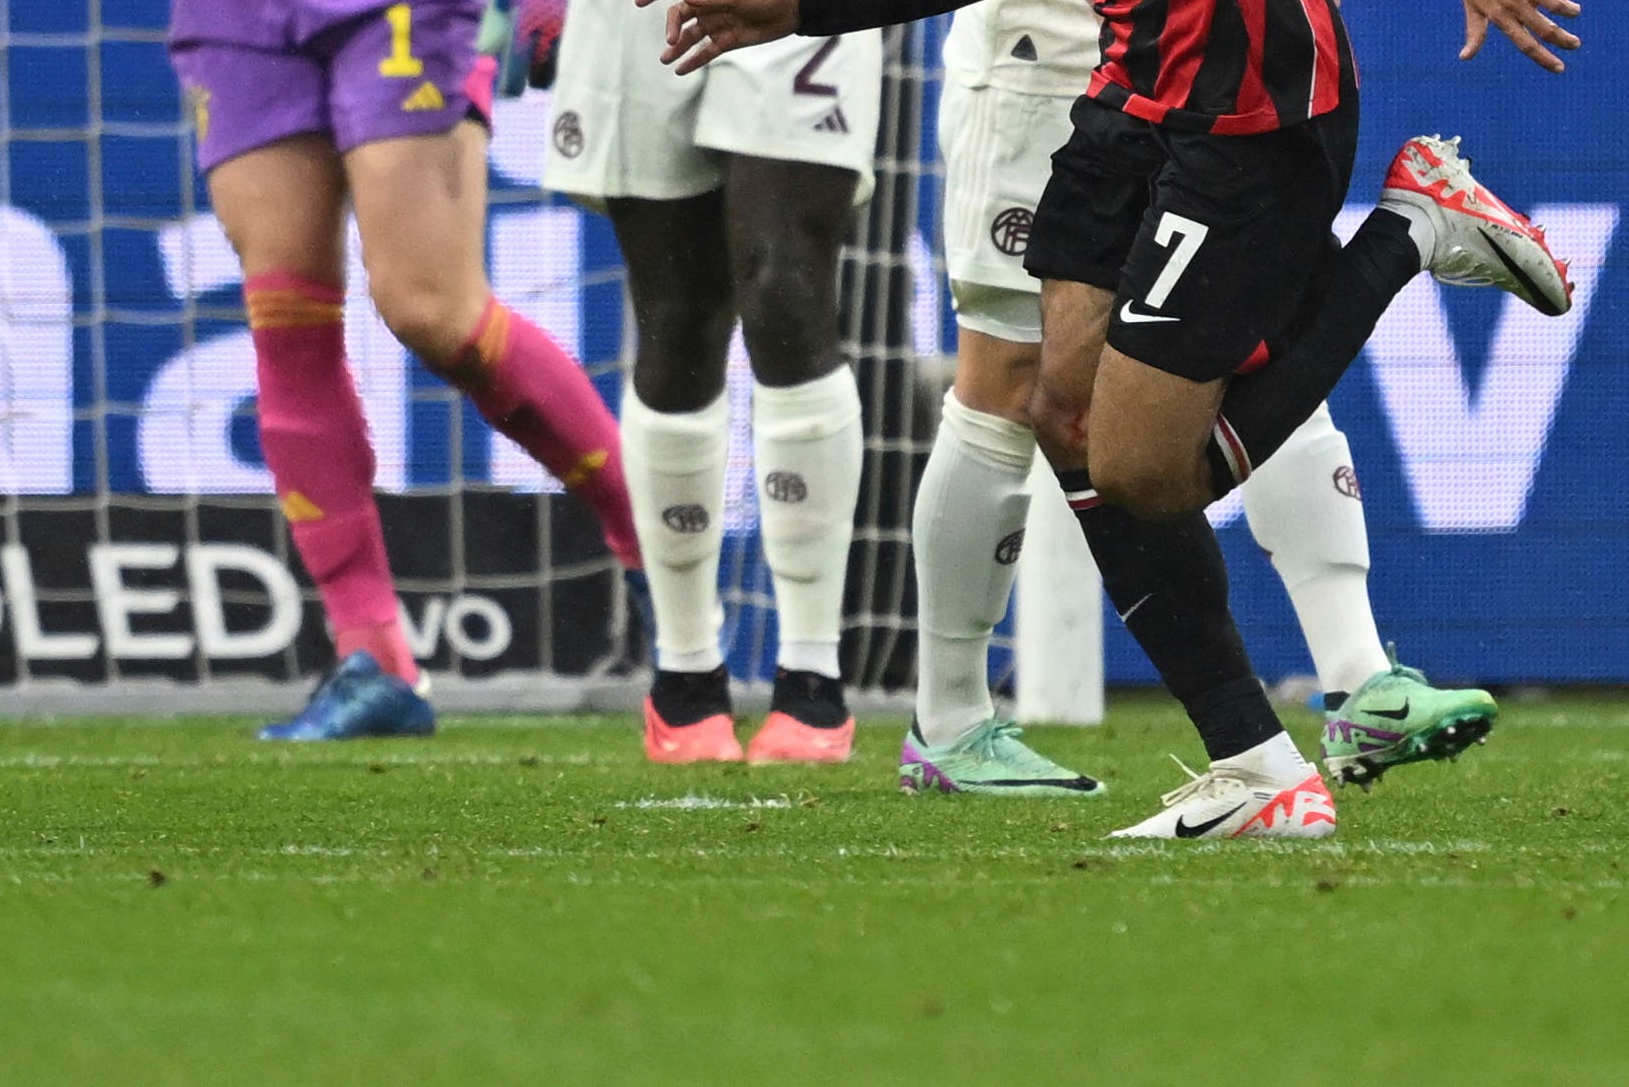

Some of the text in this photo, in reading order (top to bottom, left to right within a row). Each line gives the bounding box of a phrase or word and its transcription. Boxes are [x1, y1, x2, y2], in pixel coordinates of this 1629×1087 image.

[378, 3, 424, 77] 1
[793, 34, 840, 97] 2
[1144, 211, 1210, 309] 7
[398, 594, 513, 661] vo
